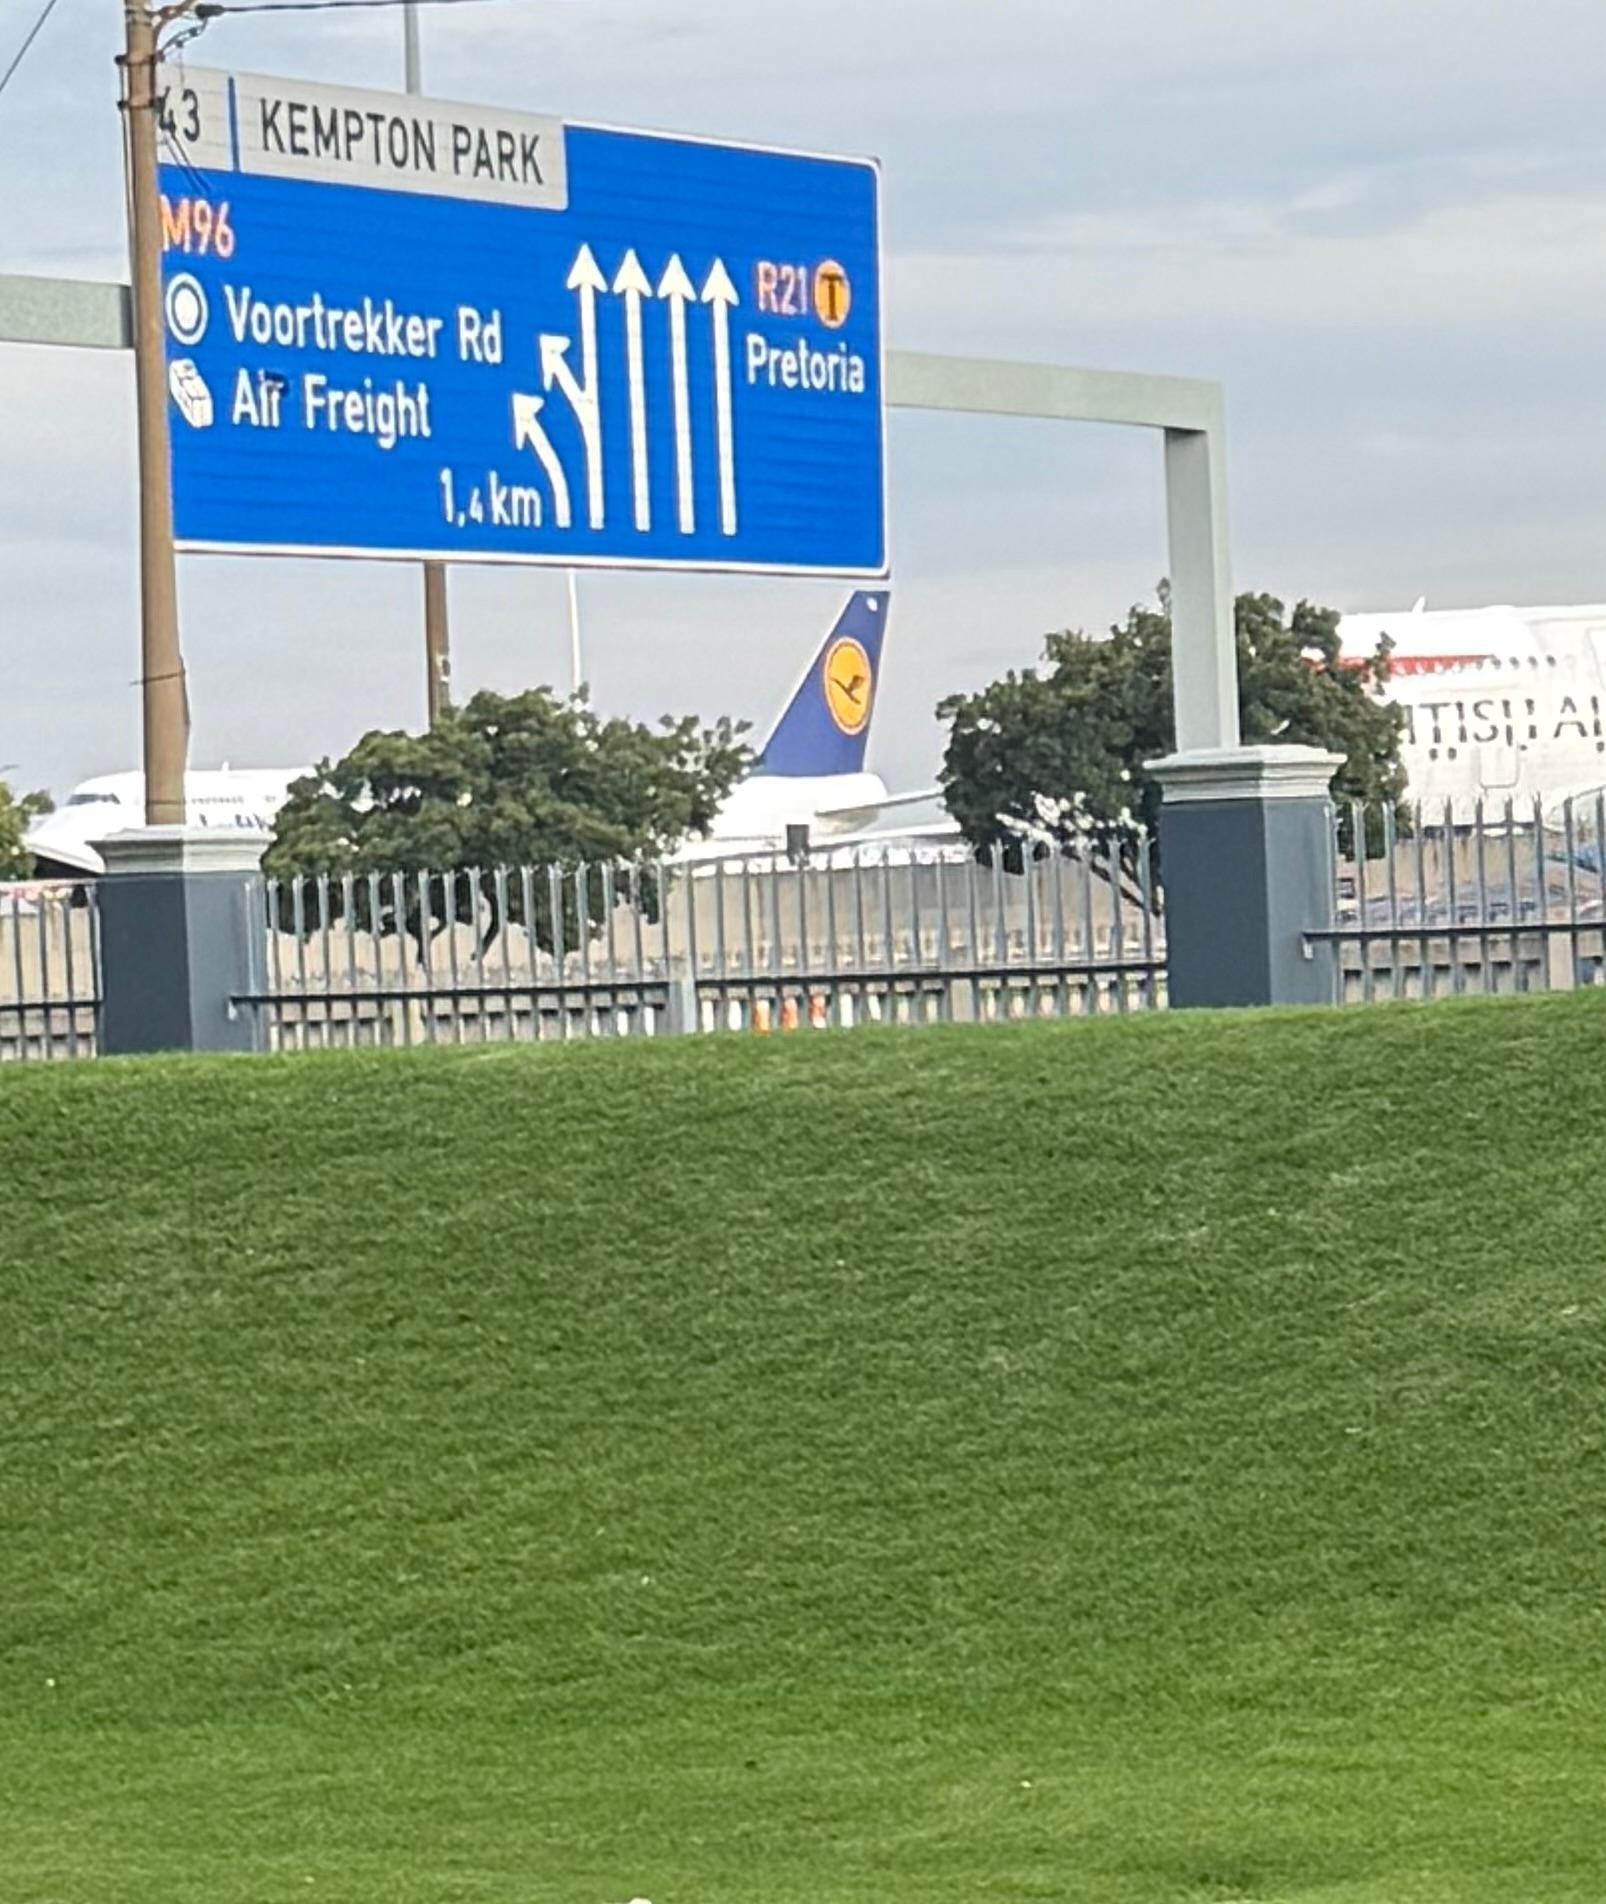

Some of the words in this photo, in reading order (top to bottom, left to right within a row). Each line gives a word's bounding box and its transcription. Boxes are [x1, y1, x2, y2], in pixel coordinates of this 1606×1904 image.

[260, 97, 437, 173] KEMPTON
[452, 124, 545, 186] PARK
[159, 194, 235, 258] M96
[757, 261, 808, 315] R21
[224, 284, 444, 360] Voortrekker
[457, 306, 503, 365] Rd
[746, 332, 866, 394] Pretoria
[232, 367, 286, 429] Air
[303, 373, 432, 451] Freight
[1405, 698, 1539, 746] ITISH
